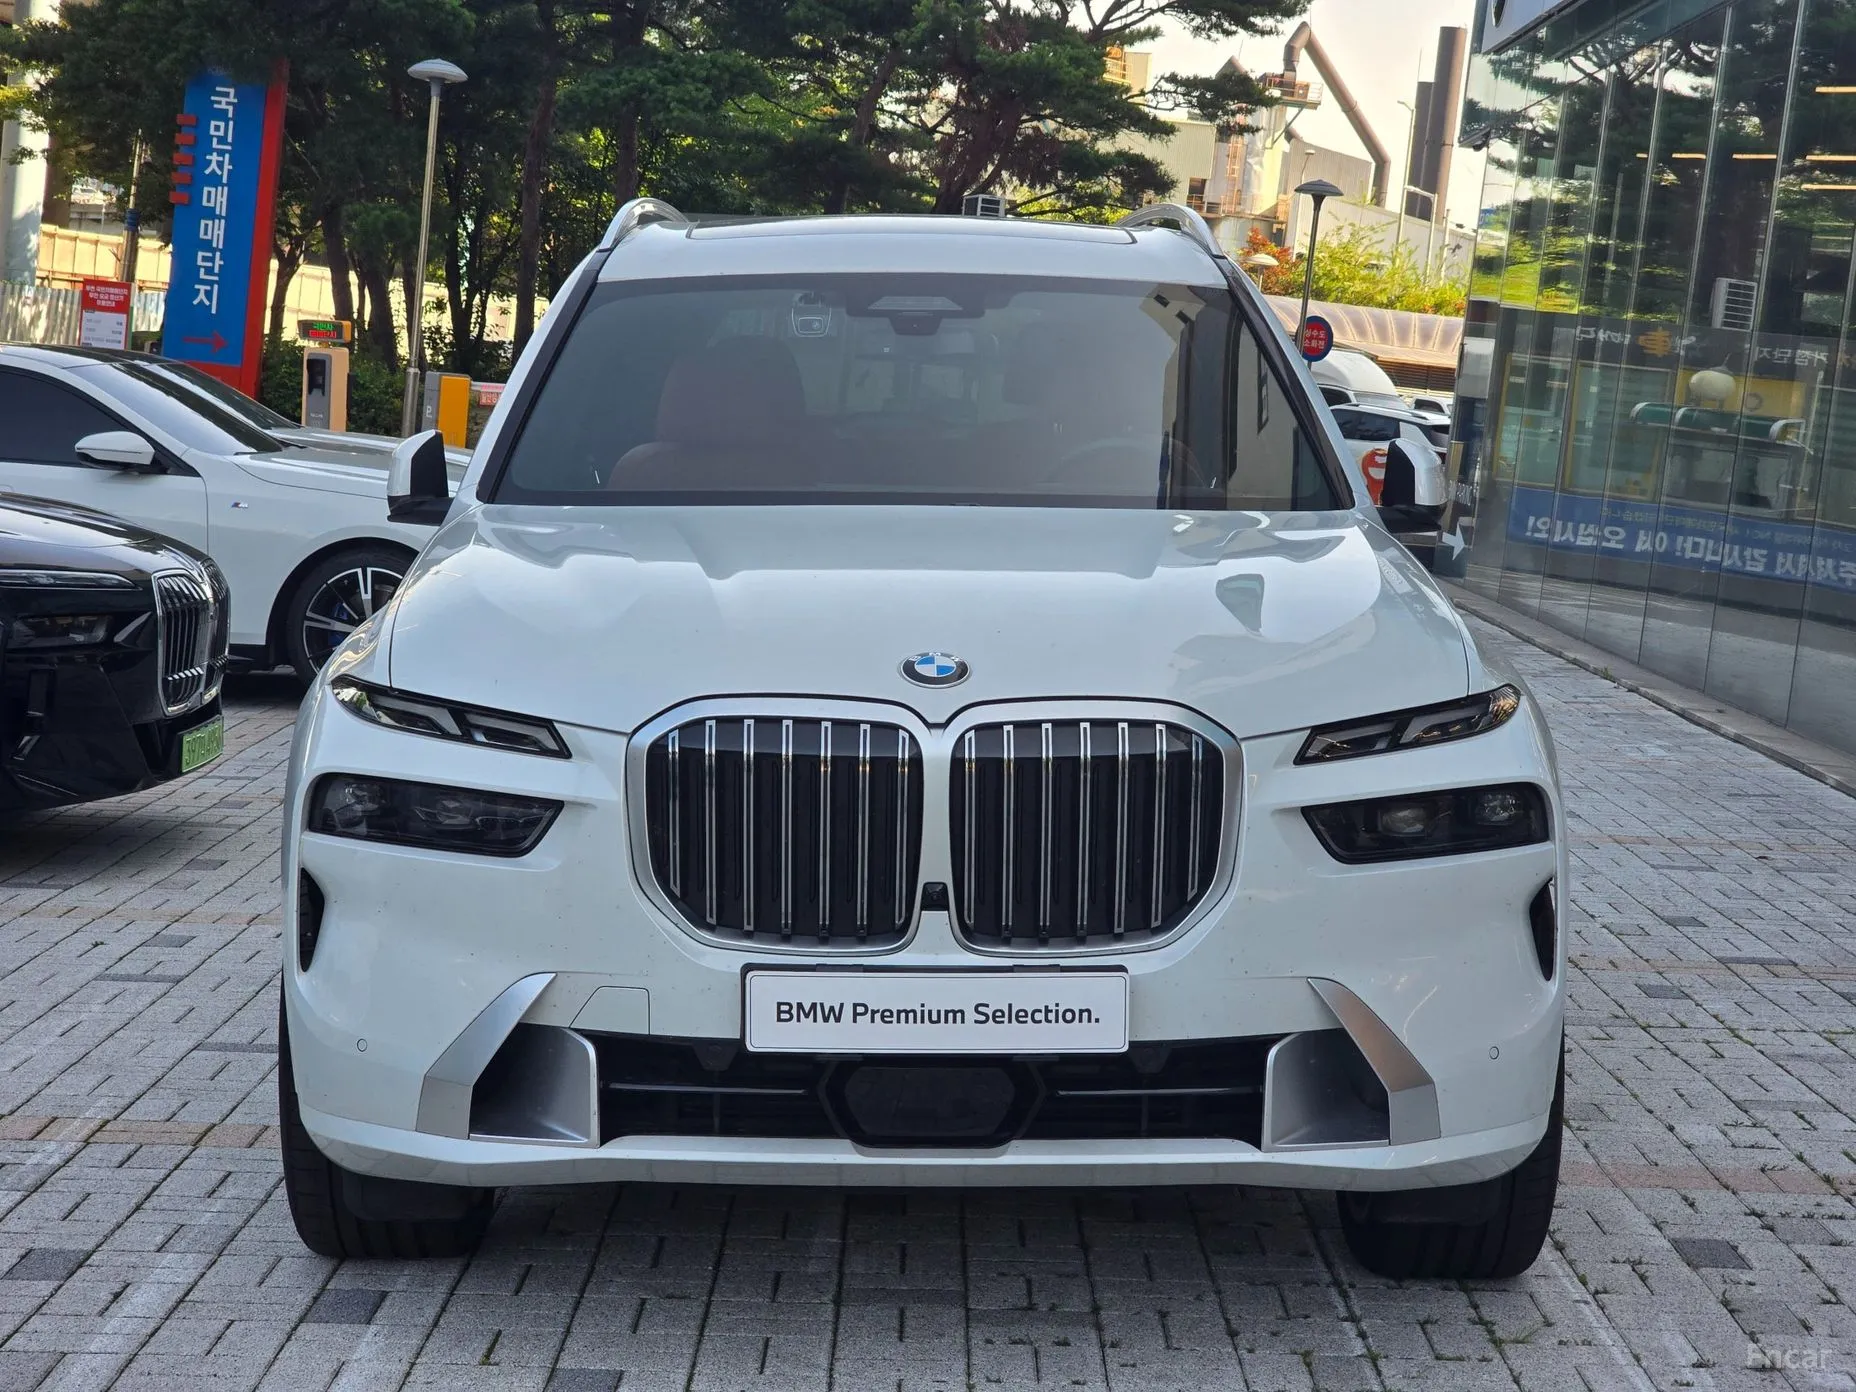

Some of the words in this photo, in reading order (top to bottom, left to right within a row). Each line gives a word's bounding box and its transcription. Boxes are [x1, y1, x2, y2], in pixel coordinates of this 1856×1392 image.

[192, 86, 238, 315] 국민차매매단지
[776, 1001, 845, 1023] BMW
[852, 1002, 966, 1024] Premium
[974, 1003, 1101, 1024] Selection.
